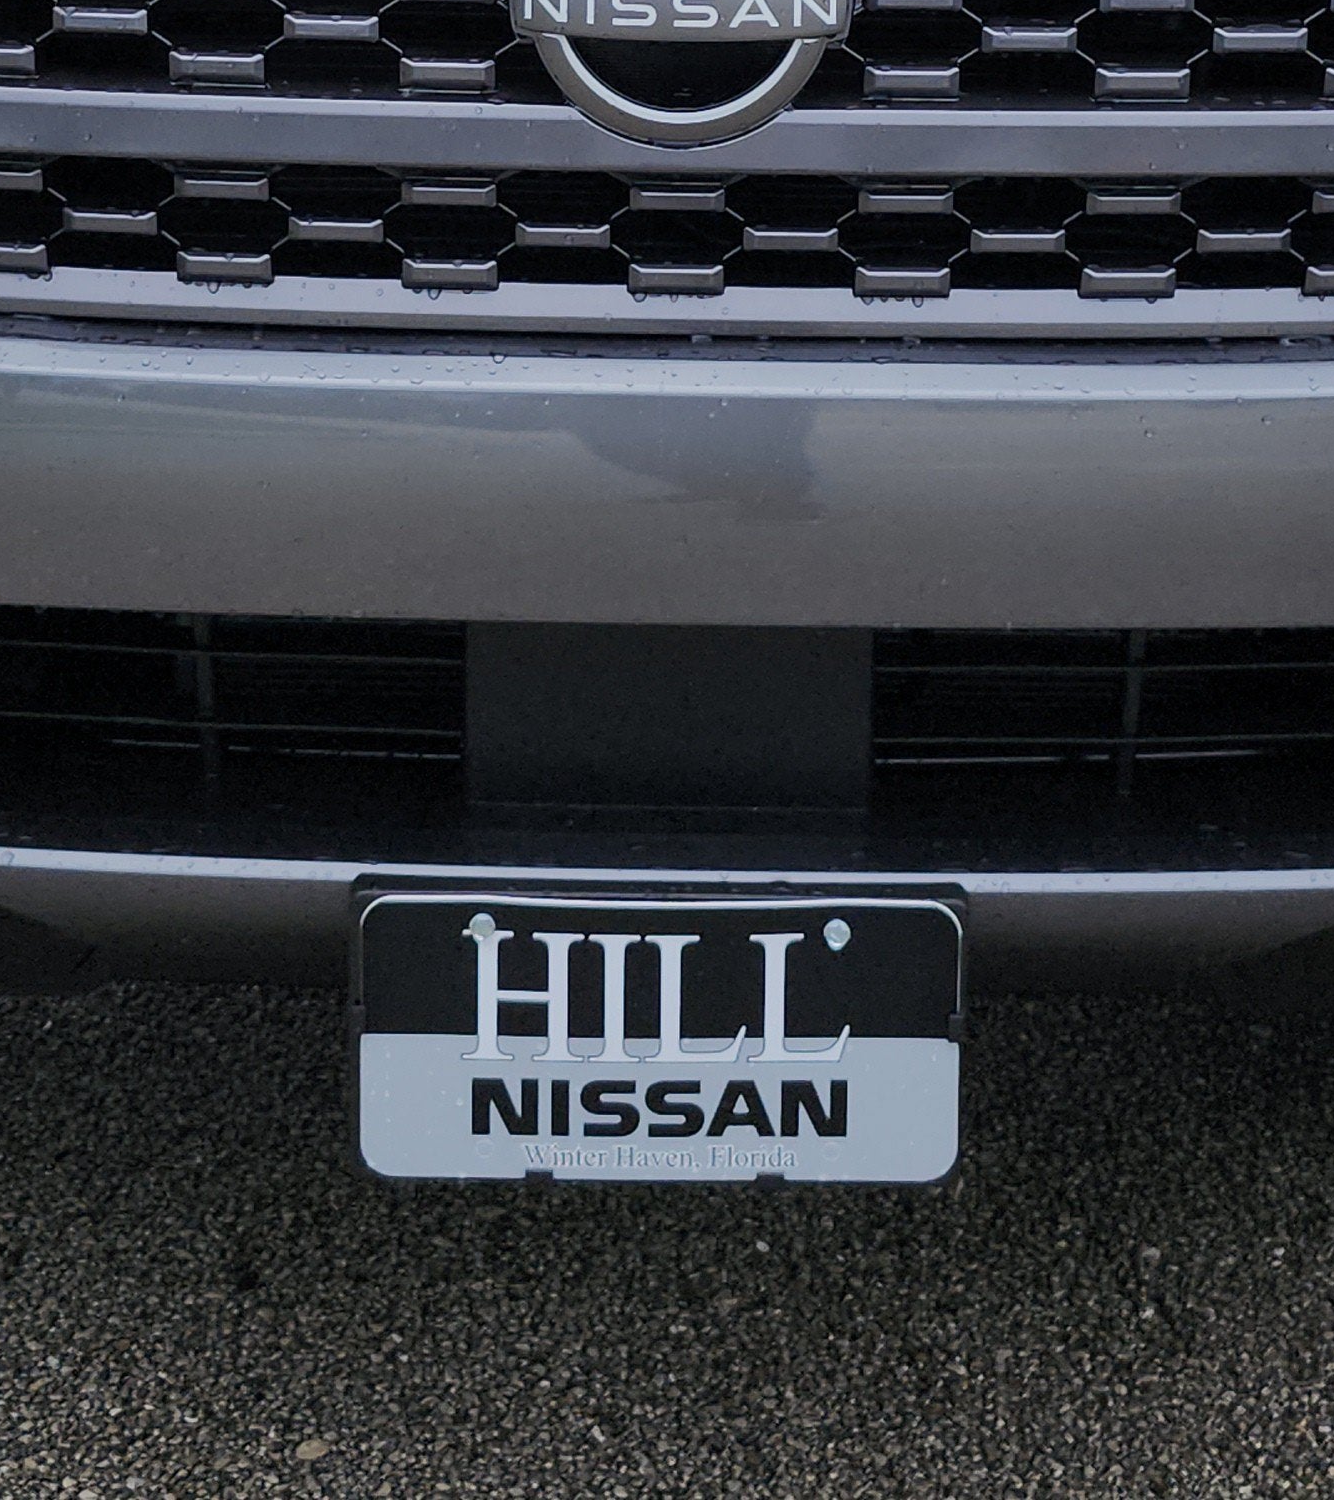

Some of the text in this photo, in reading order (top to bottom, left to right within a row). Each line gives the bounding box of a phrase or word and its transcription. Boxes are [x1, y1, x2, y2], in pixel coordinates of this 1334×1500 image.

[462, 929, 850, 1062] HILL
[471, 1077, 849, 1137] NISSAN
[524, 1143, 797, 1170] Winter Haven, Florida
